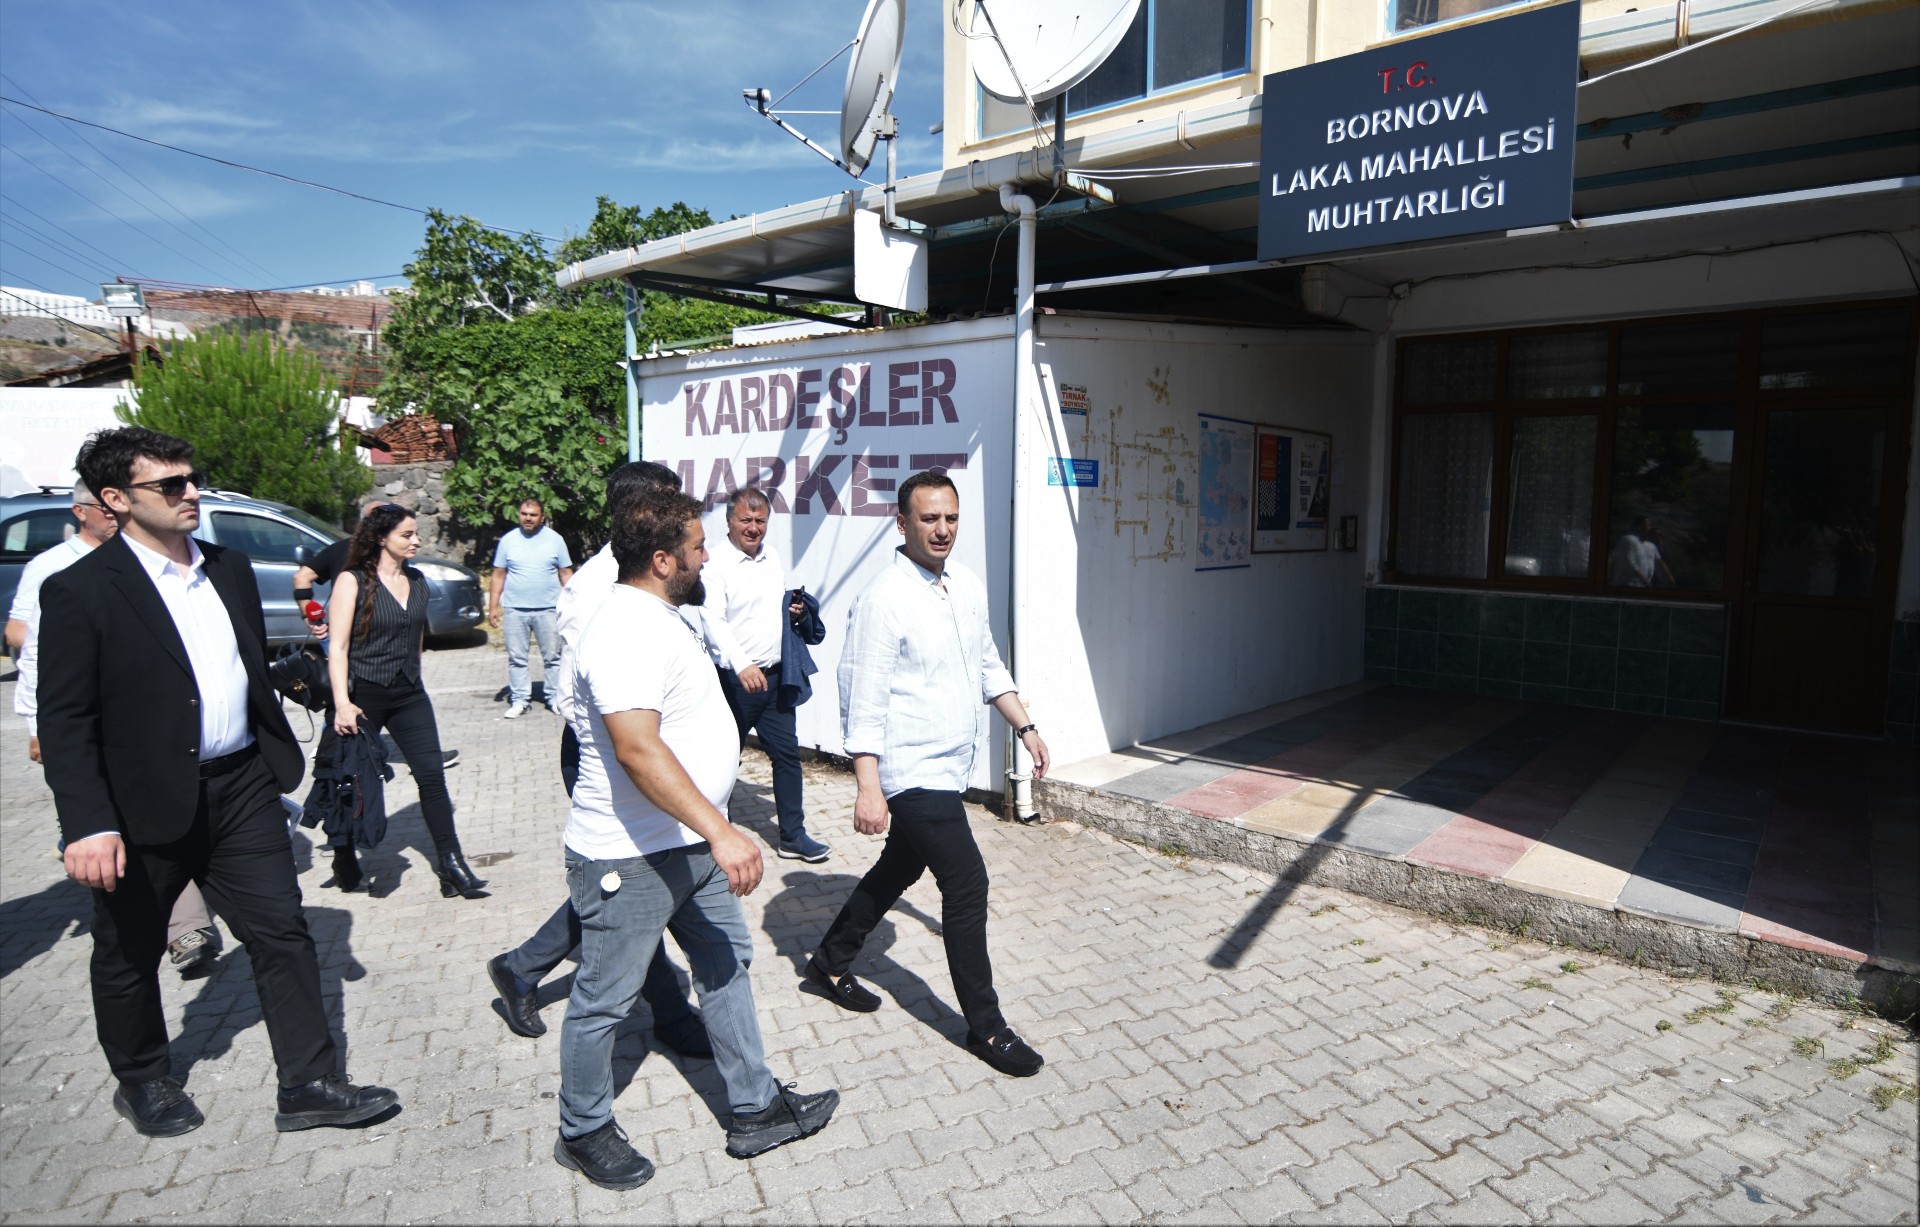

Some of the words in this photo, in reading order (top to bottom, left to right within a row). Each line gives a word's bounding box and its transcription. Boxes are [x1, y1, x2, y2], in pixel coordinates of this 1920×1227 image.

[1377, 61, 1436, 94] T.C.
[1326, 90, 1489, 145] BORNOVA
[1272, 160, 1353, 197] LAKA
[1360, 118, 1555, 182] MAHALLESİ
[1307, 175, 1506, 233] MUHTARLIĞI
[685, 358, 960, 446] KARDEŞLER
[1061, 392, 1086, 401] TIRNAK
